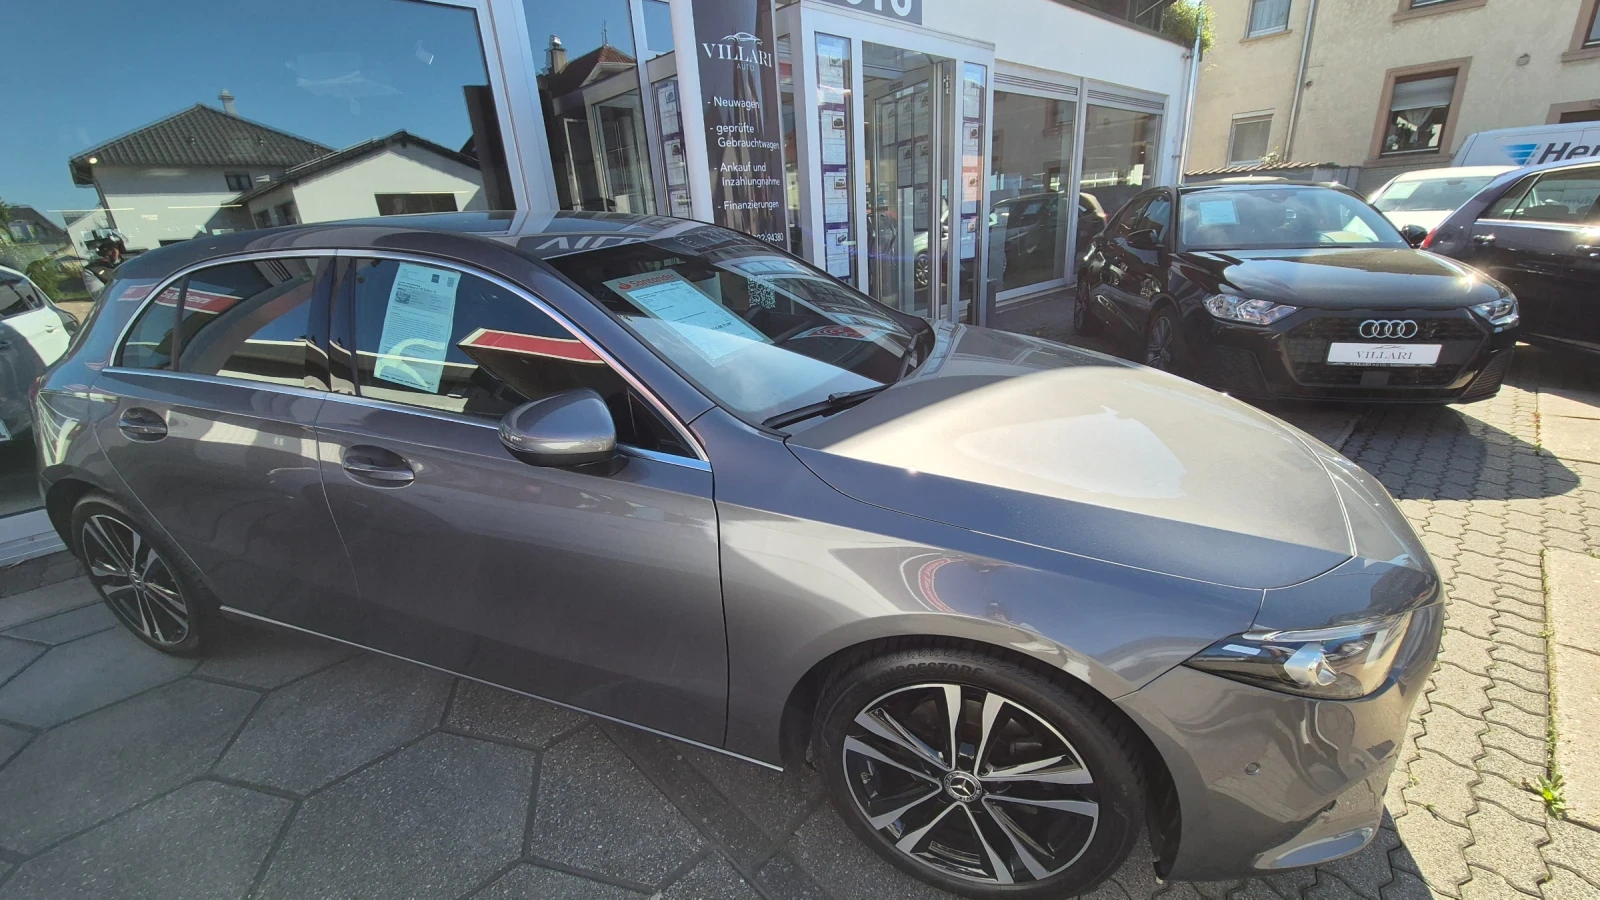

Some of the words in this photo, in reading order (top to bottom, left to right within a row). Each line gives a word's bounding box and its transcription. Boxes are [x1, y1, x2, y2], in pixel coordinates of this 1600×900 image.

[702, 43, 772, 67] VILLARI
[737, 63, 754, 71] AUTO
[713, 96, 760, 111] Neuwagen
[716, 122, 754, 135] geprüfte
[718, 136, 779, 151] Gebrauchtwagen
[720, 162, 751, 172] Ankauf
[753, 162, 766, 172] und
[722, 176, 780, 188] Inzahlungnahme
[723, 200, 779, 211] Finanzierungen
[629, 272, 676, 288] Santander
[1357, 351, 1412, 360] VILLARI
